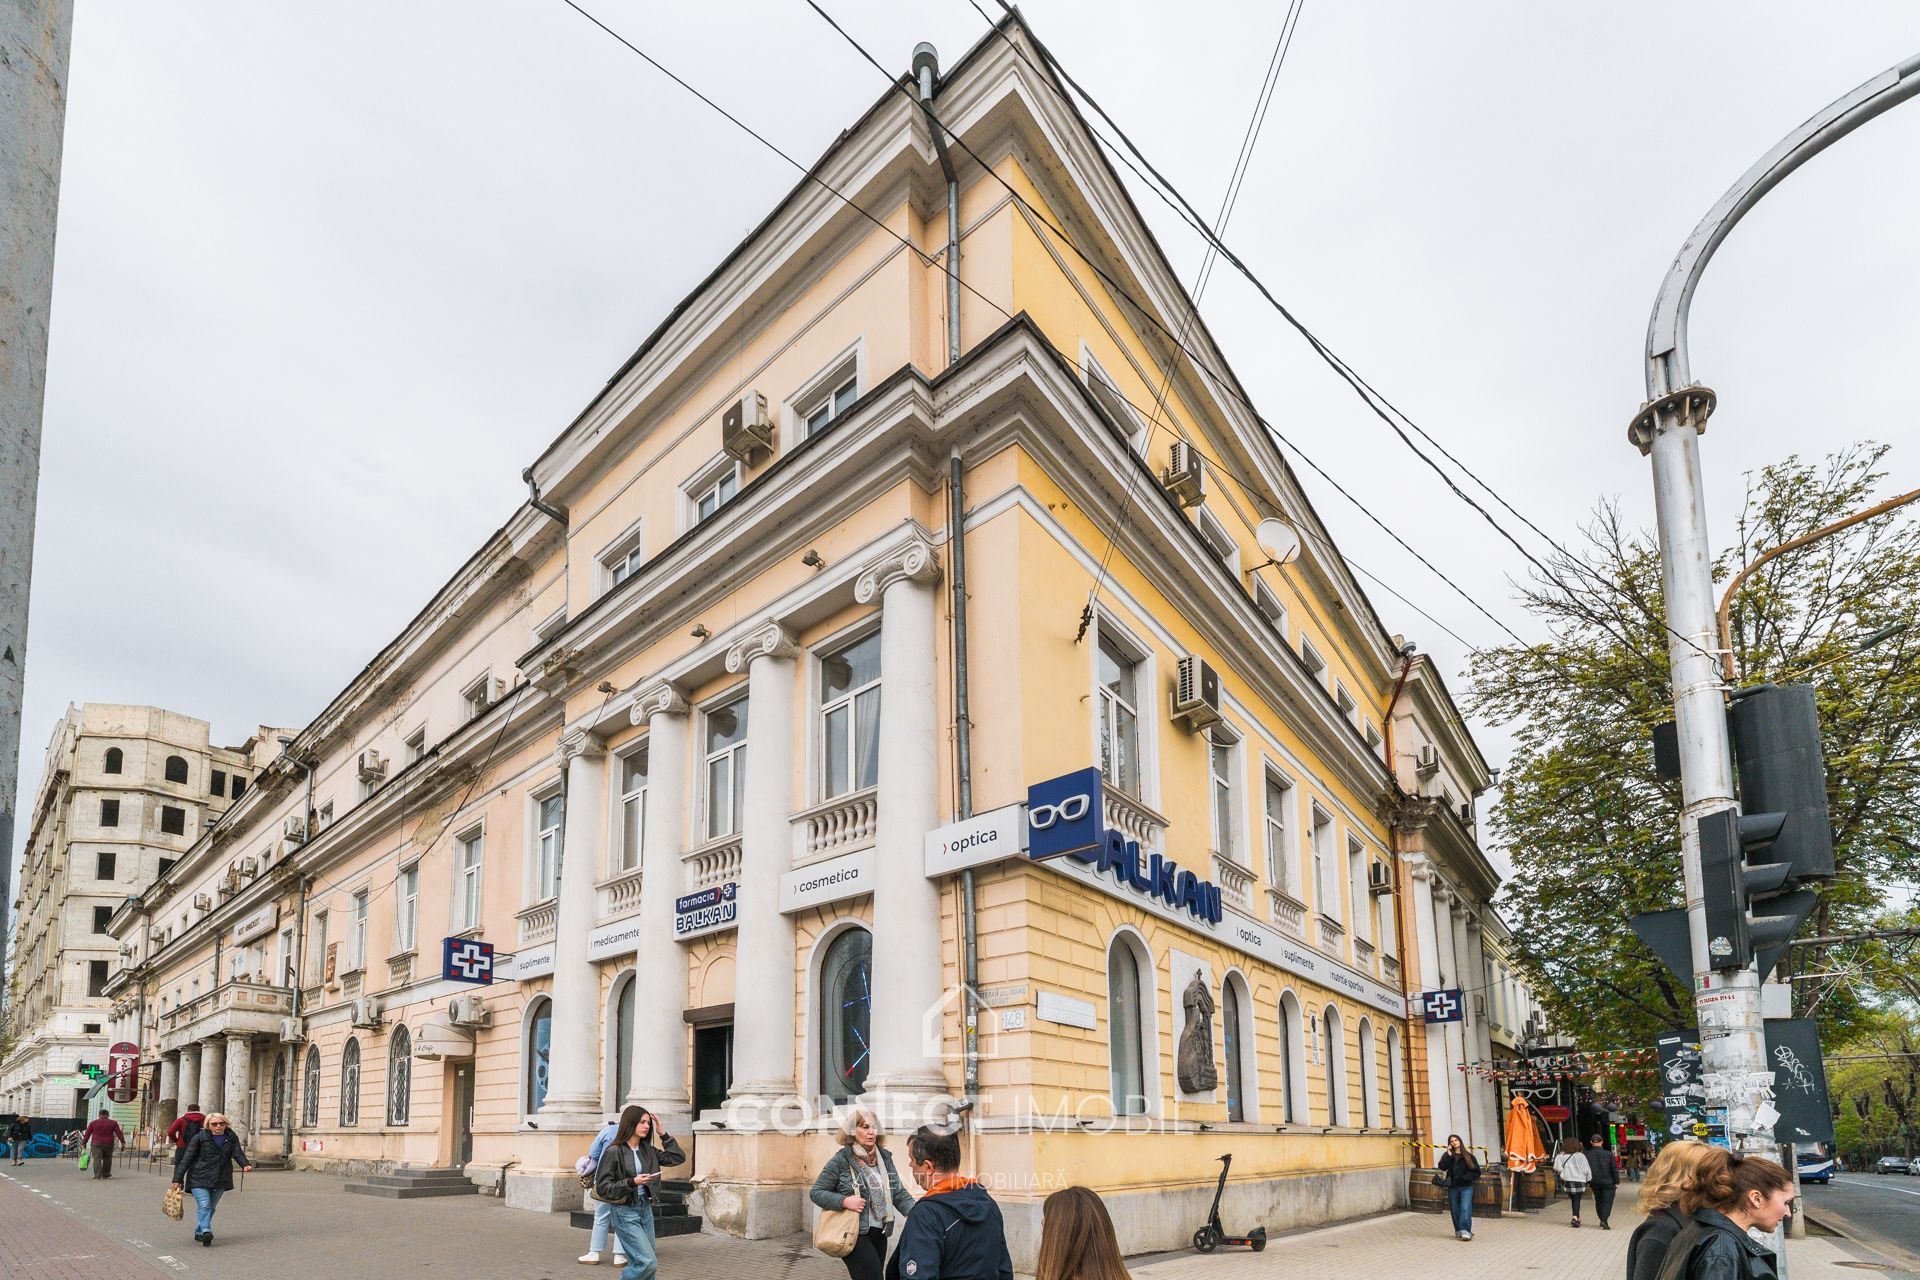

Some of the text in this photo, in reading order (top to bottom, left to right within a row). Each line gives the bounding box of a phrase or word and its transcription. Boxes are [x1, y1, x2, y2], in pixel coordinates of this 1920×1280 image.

[951, 829, 998, 852] optica
[799, 867, 859, 893] cosmetica
[679, 892, 715, 910] farmacia
[676, 902, 737, 933] BALKAN
[593, 928, 640, 948] medicamente
[1240, 929, 1262, 946] optica
[519, 955, 550, 971] suplimente
[1284, 949, 1315, 970] suplimente
[1004, 1011, 1023, 1026] 148
